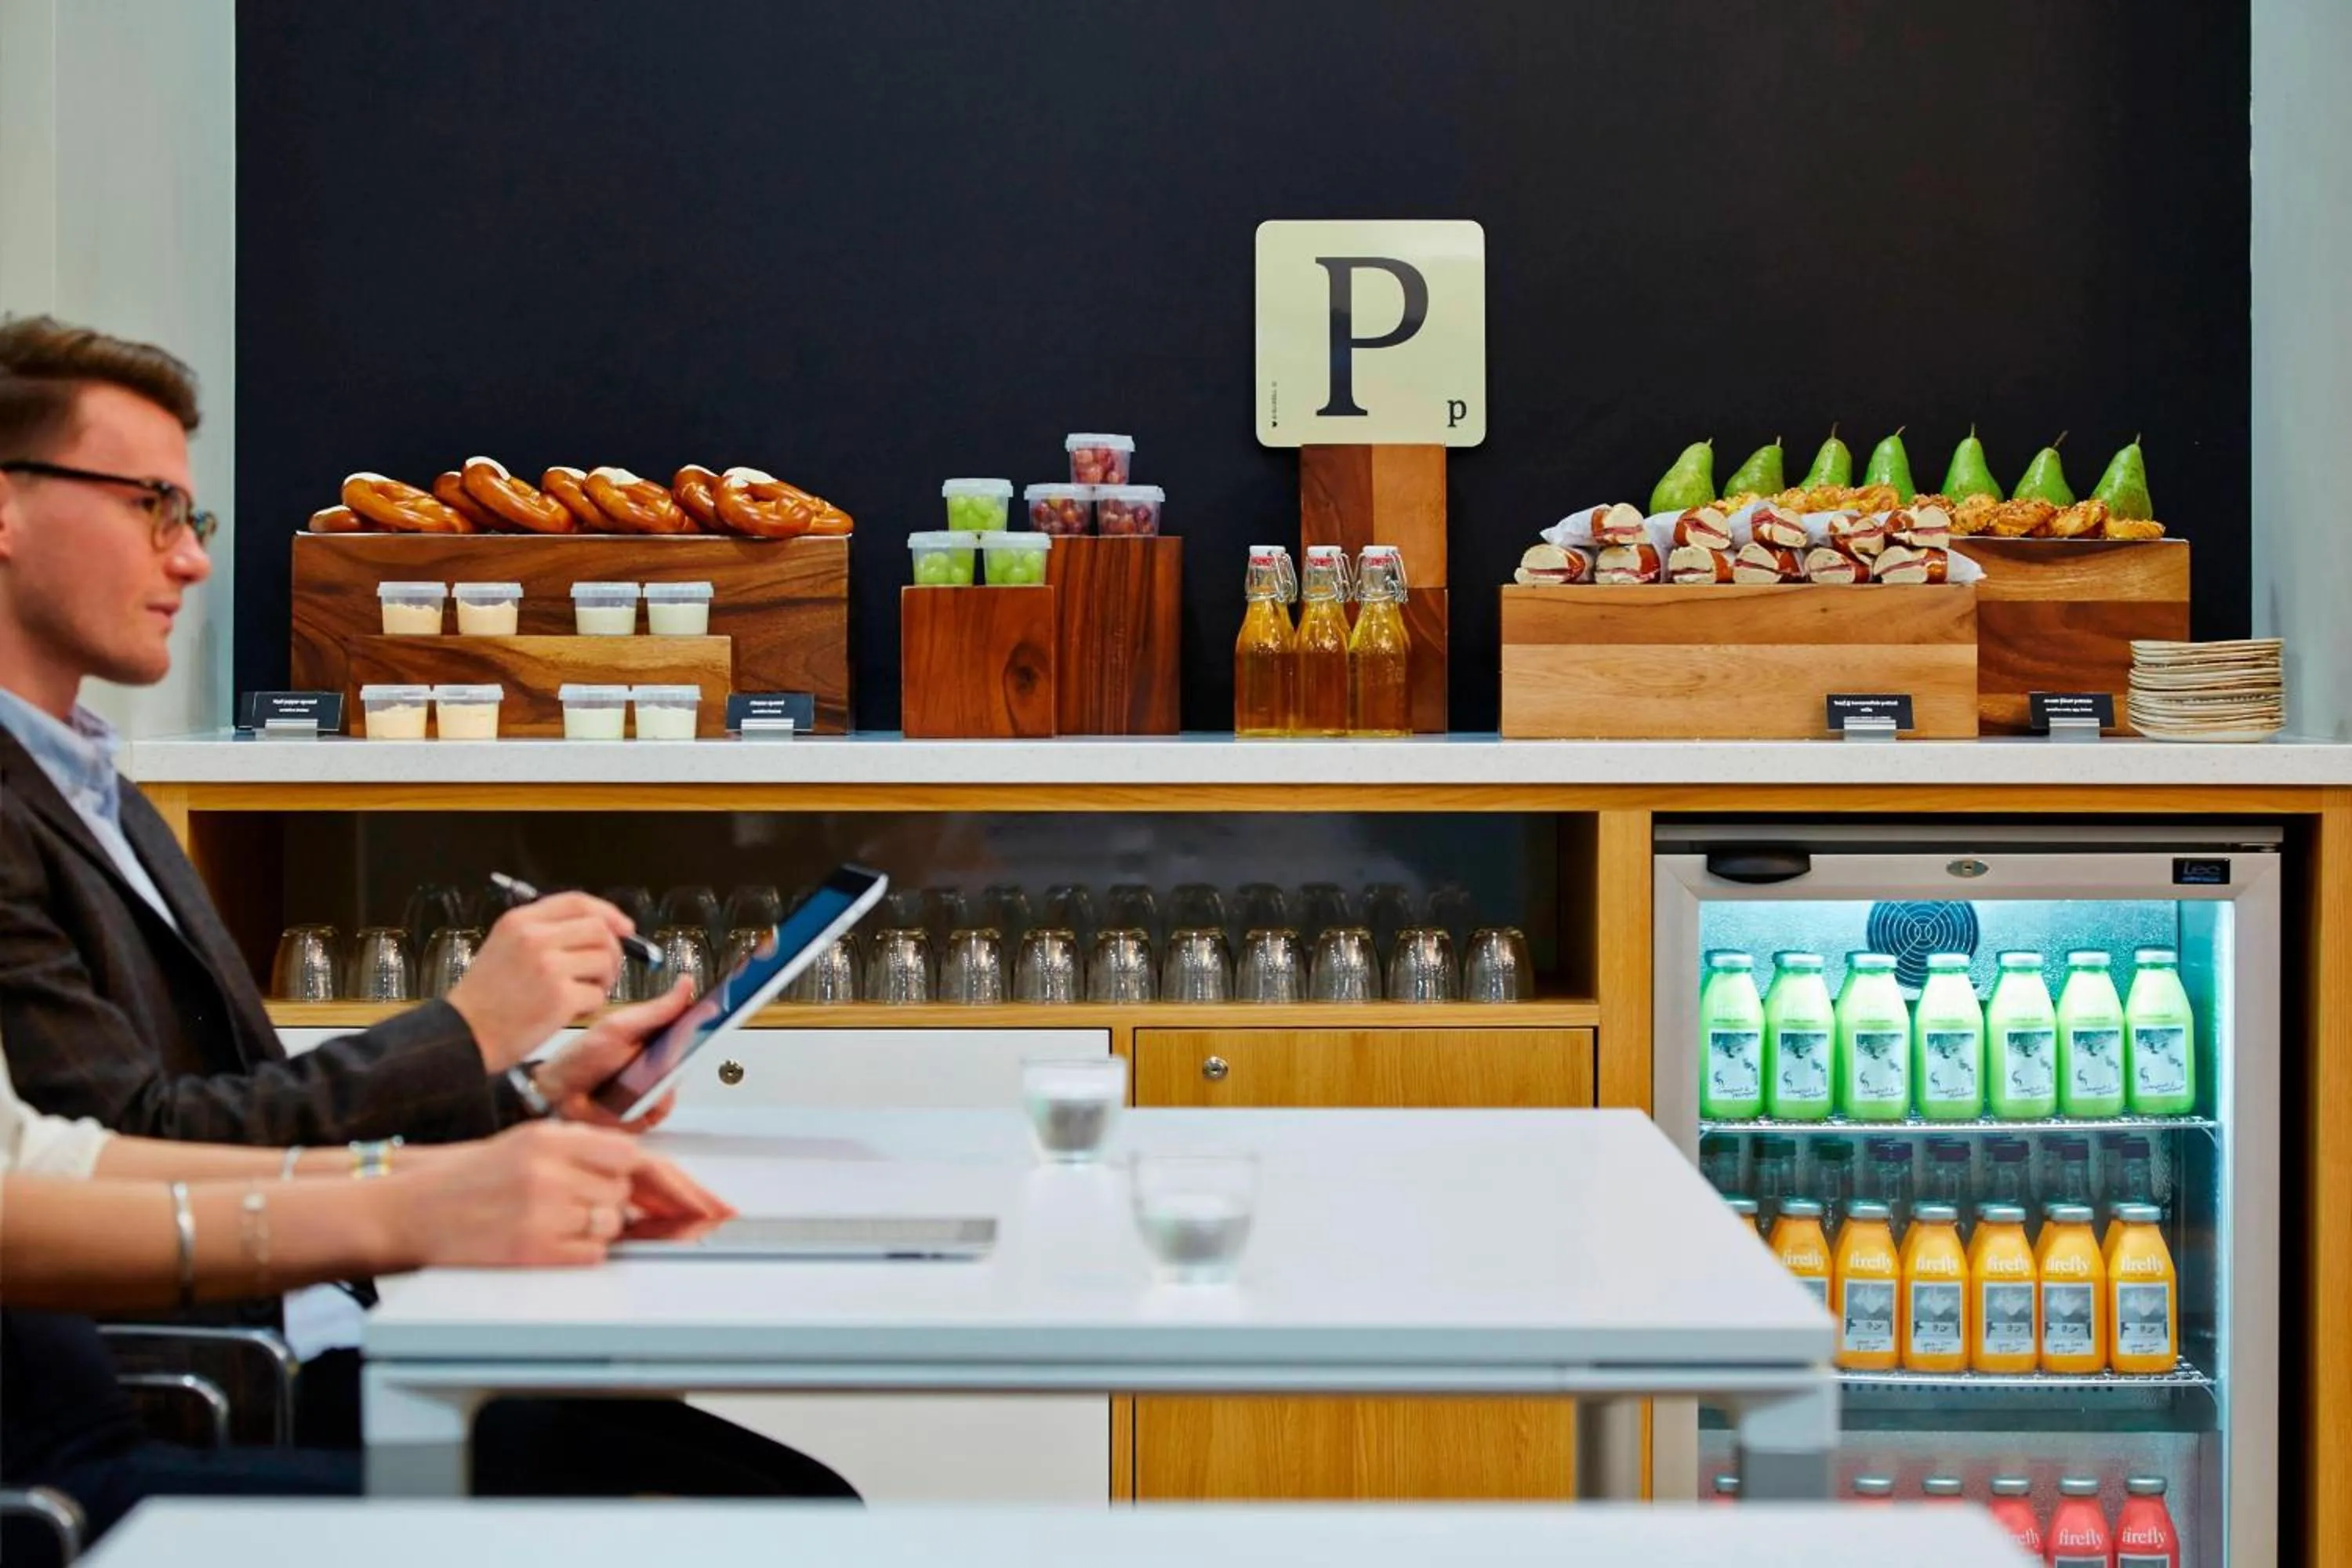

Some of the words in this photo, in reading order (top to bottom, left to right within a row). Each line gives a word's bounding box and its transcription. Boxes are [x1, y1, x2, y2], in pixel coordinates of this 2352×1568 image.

[1315, 256, 1429, 416] P
[1447, 399, 1467, 427] p
[2058, 1527, 2105, 1550] firefly
[2122, 1526, 2167, 1549] firefly
